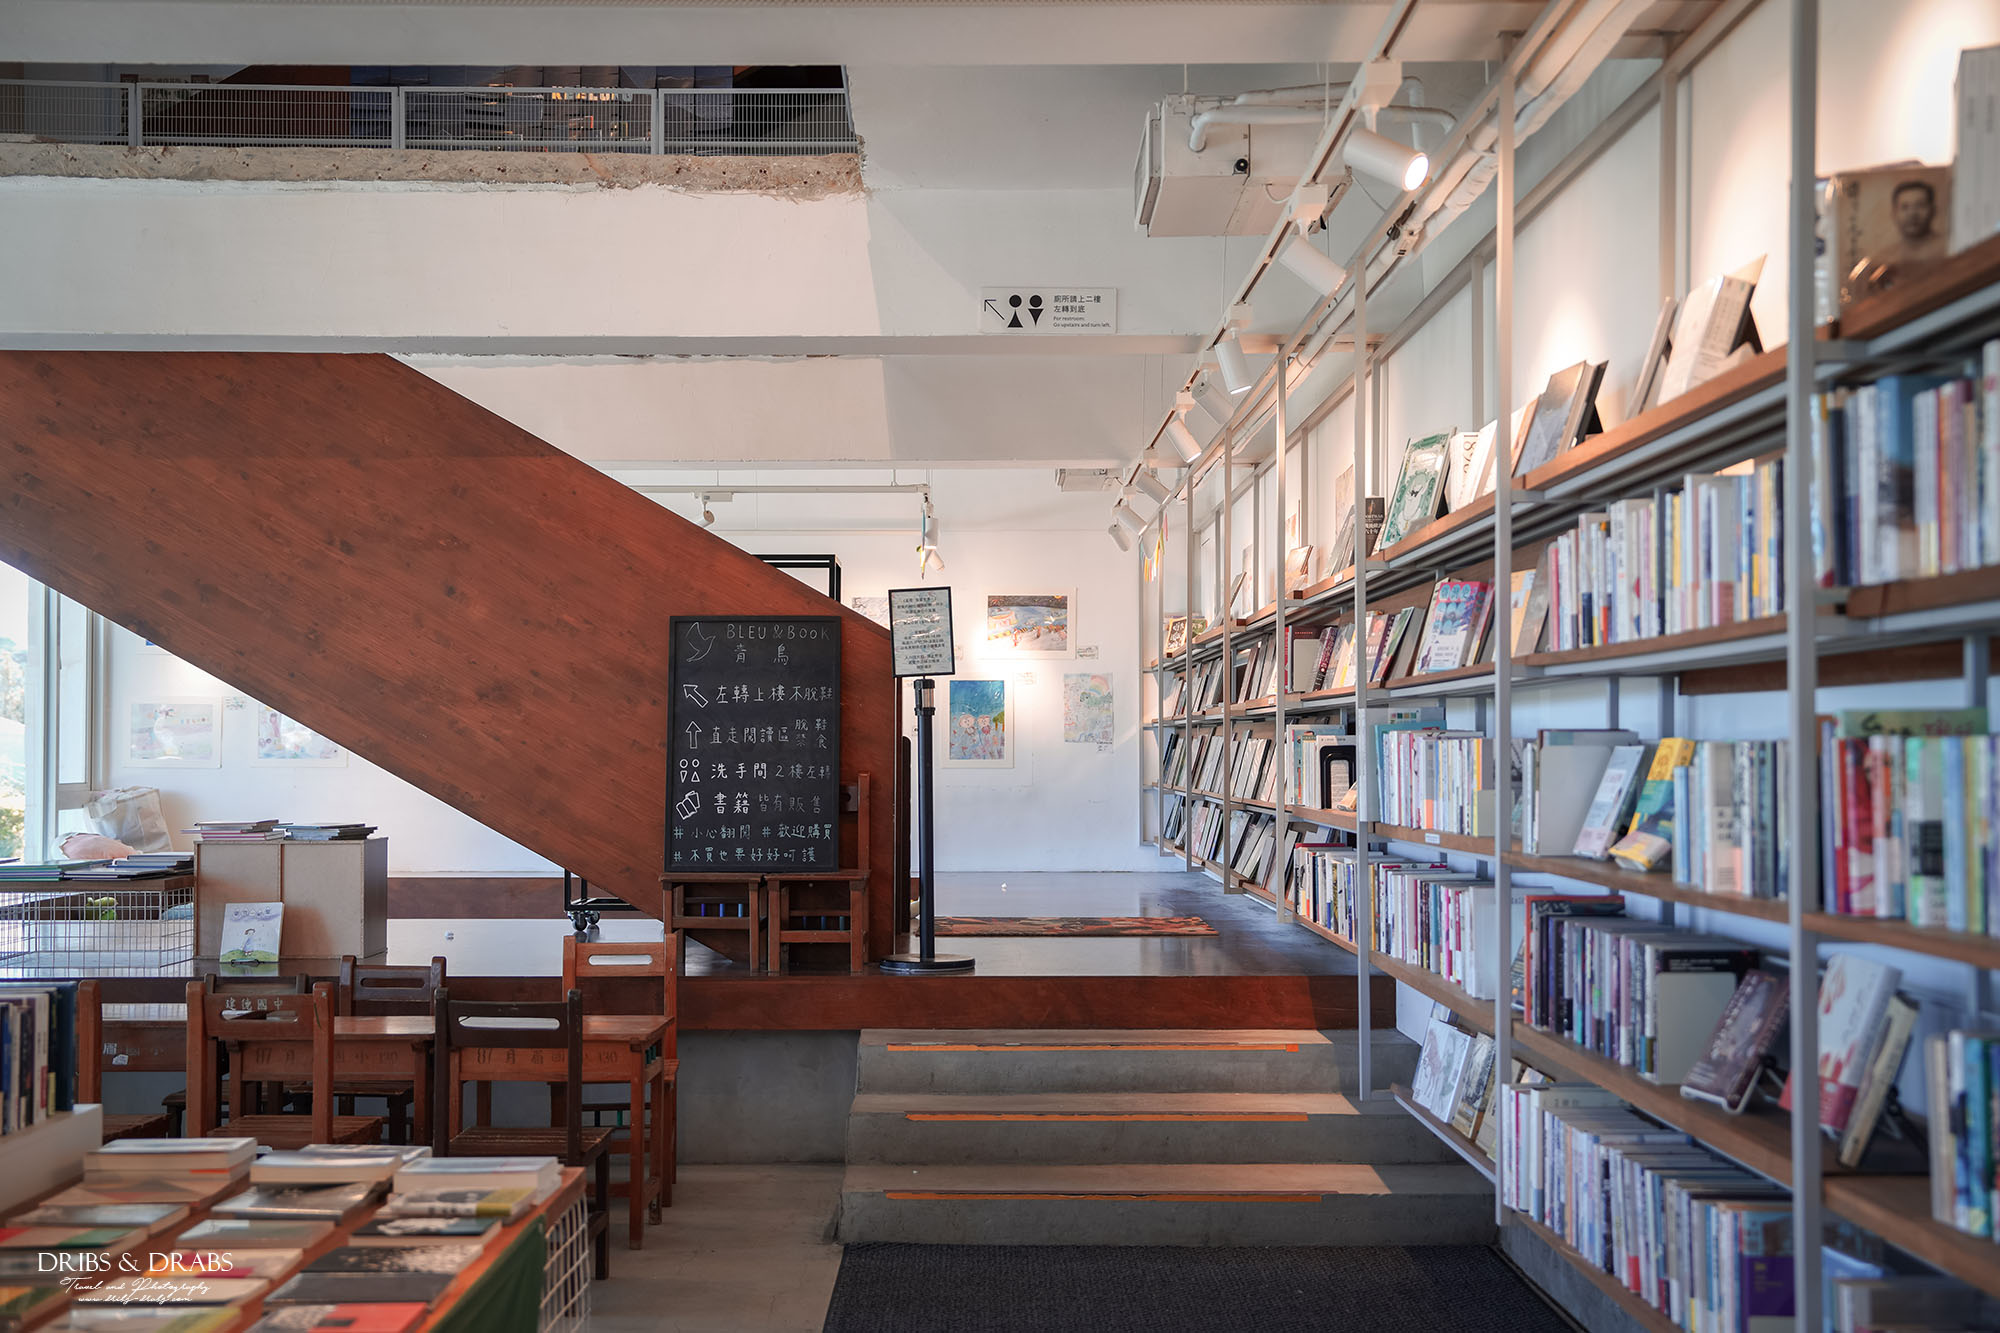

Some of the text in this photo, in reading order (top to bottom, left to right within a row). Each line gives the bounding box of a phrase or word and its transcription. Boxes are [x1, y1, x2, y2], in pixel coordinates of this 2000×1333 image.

[1053, 295, 1101, 304] 廁所請上二樓
[1053, 305, 1086, 313] 左轉到底
[726, 623, 767, 640] BLEU
[710, 762, 768, 779] 洗手間
[713, 792, 751, 814] 書籍
